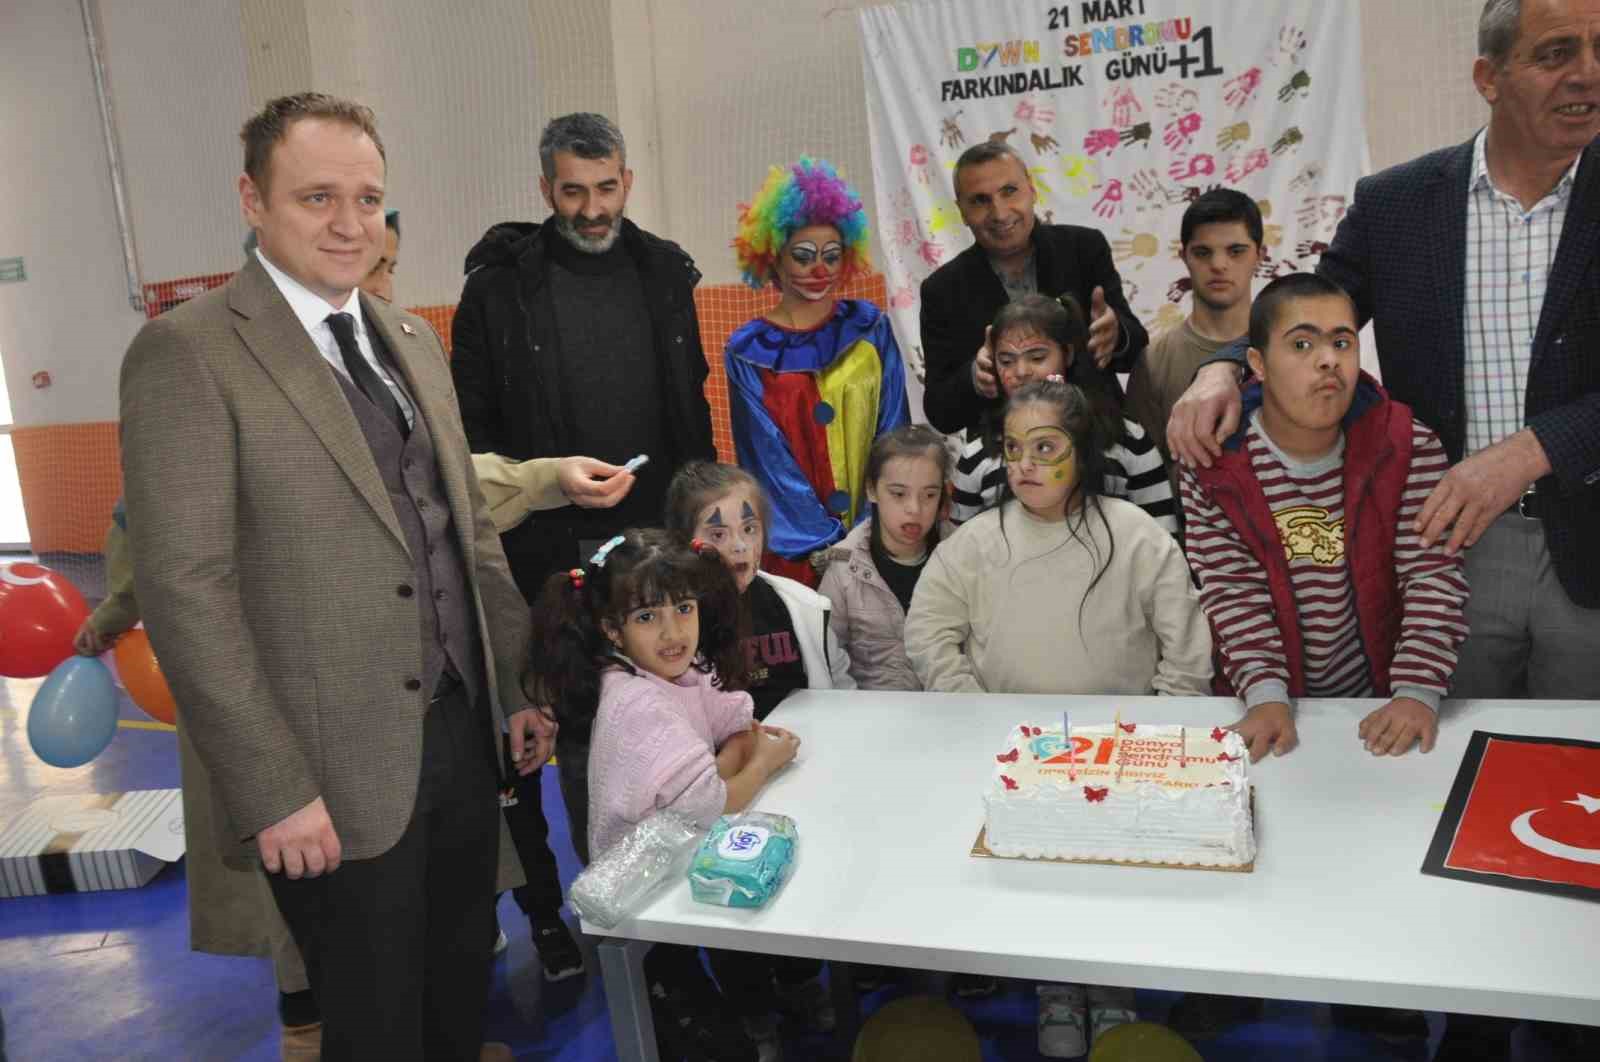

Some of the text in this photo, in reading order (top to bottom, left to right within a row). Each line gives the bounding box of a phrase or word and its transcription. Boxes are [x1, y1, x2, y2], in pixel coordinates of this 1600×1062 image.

[1047, 5, 1069, 30] 21
[1063, 16, 1192, 57] SENDROMU
[941, 66, 1084, 102] FARKINDALIK
[1105, 46, 1167, 80] GÜNÜ
[1118, 752, 1216, 764] Sendromu
[1119, 745, 1173, 754] Down
